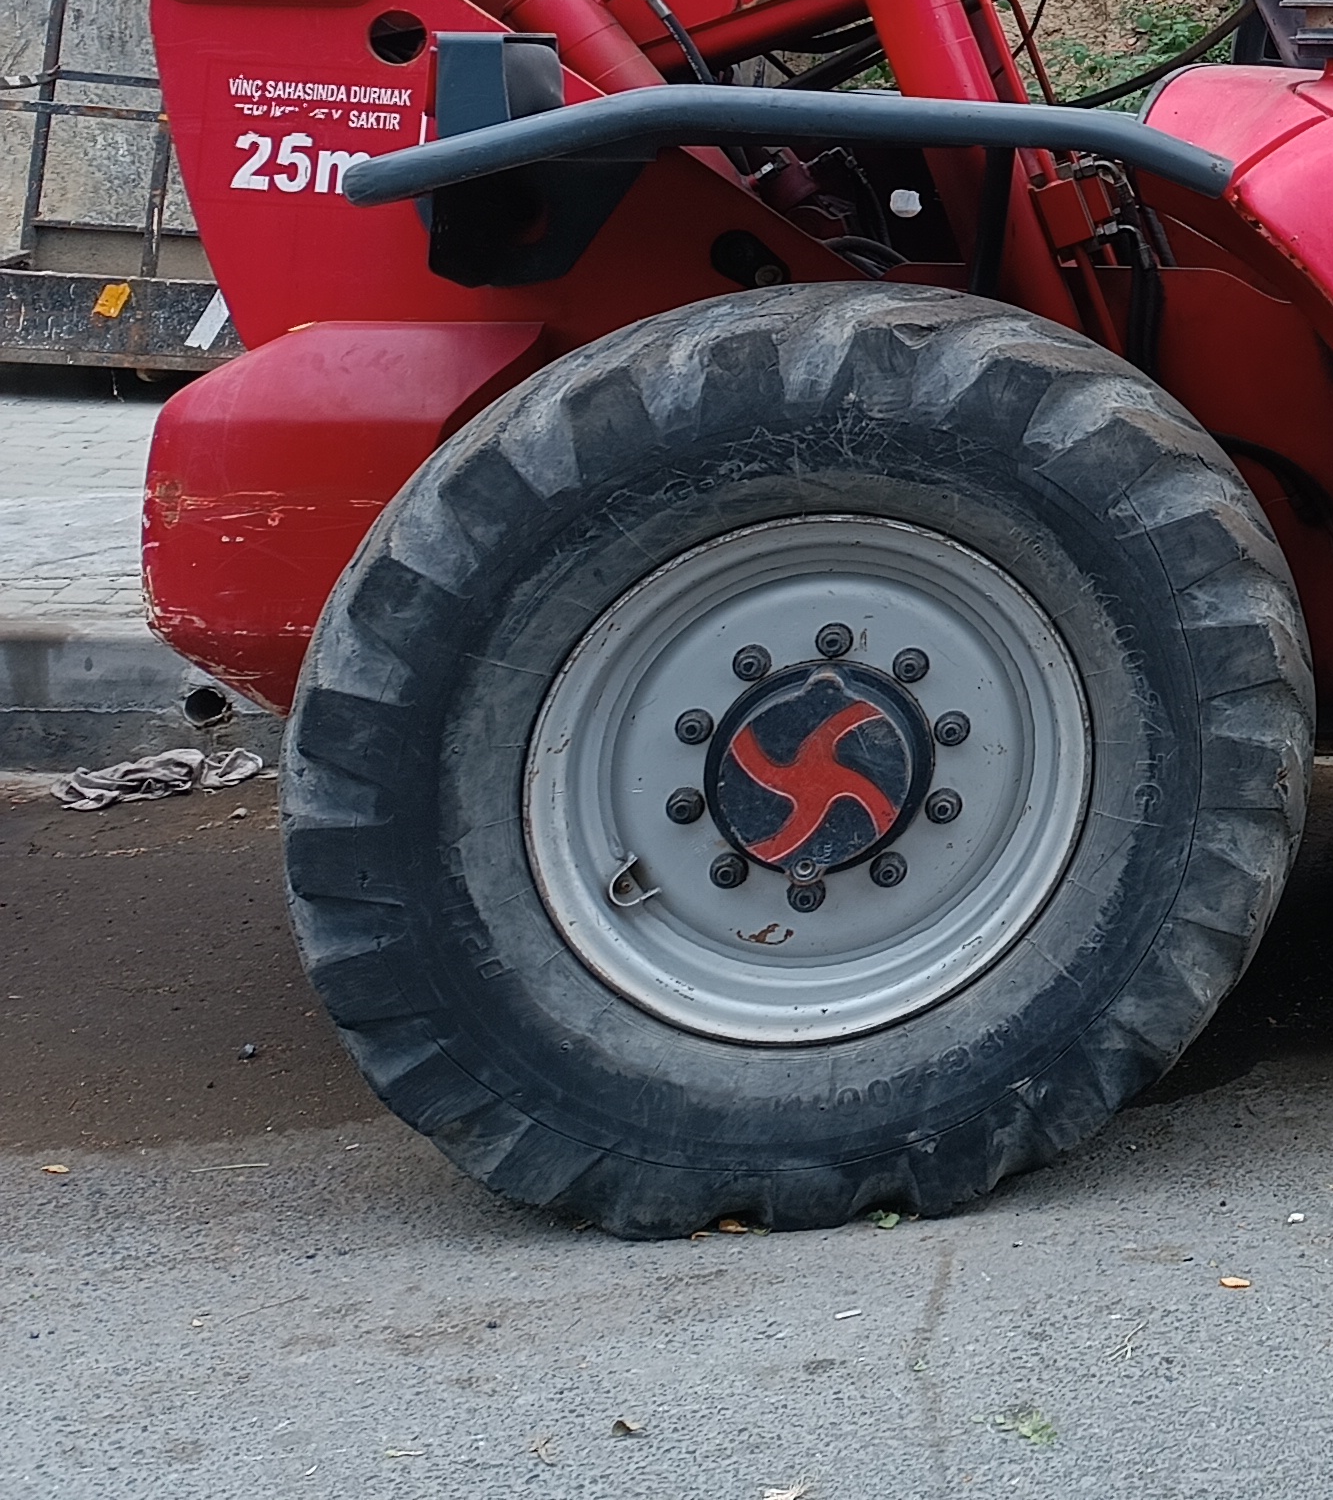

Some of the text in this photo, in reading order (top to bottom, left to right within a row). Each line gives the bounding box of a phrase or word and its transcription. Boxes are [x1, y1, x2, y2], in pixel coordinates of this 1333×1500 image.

[229, 74, 412, 106] VİNÇ SAHASINDA DURMAK
